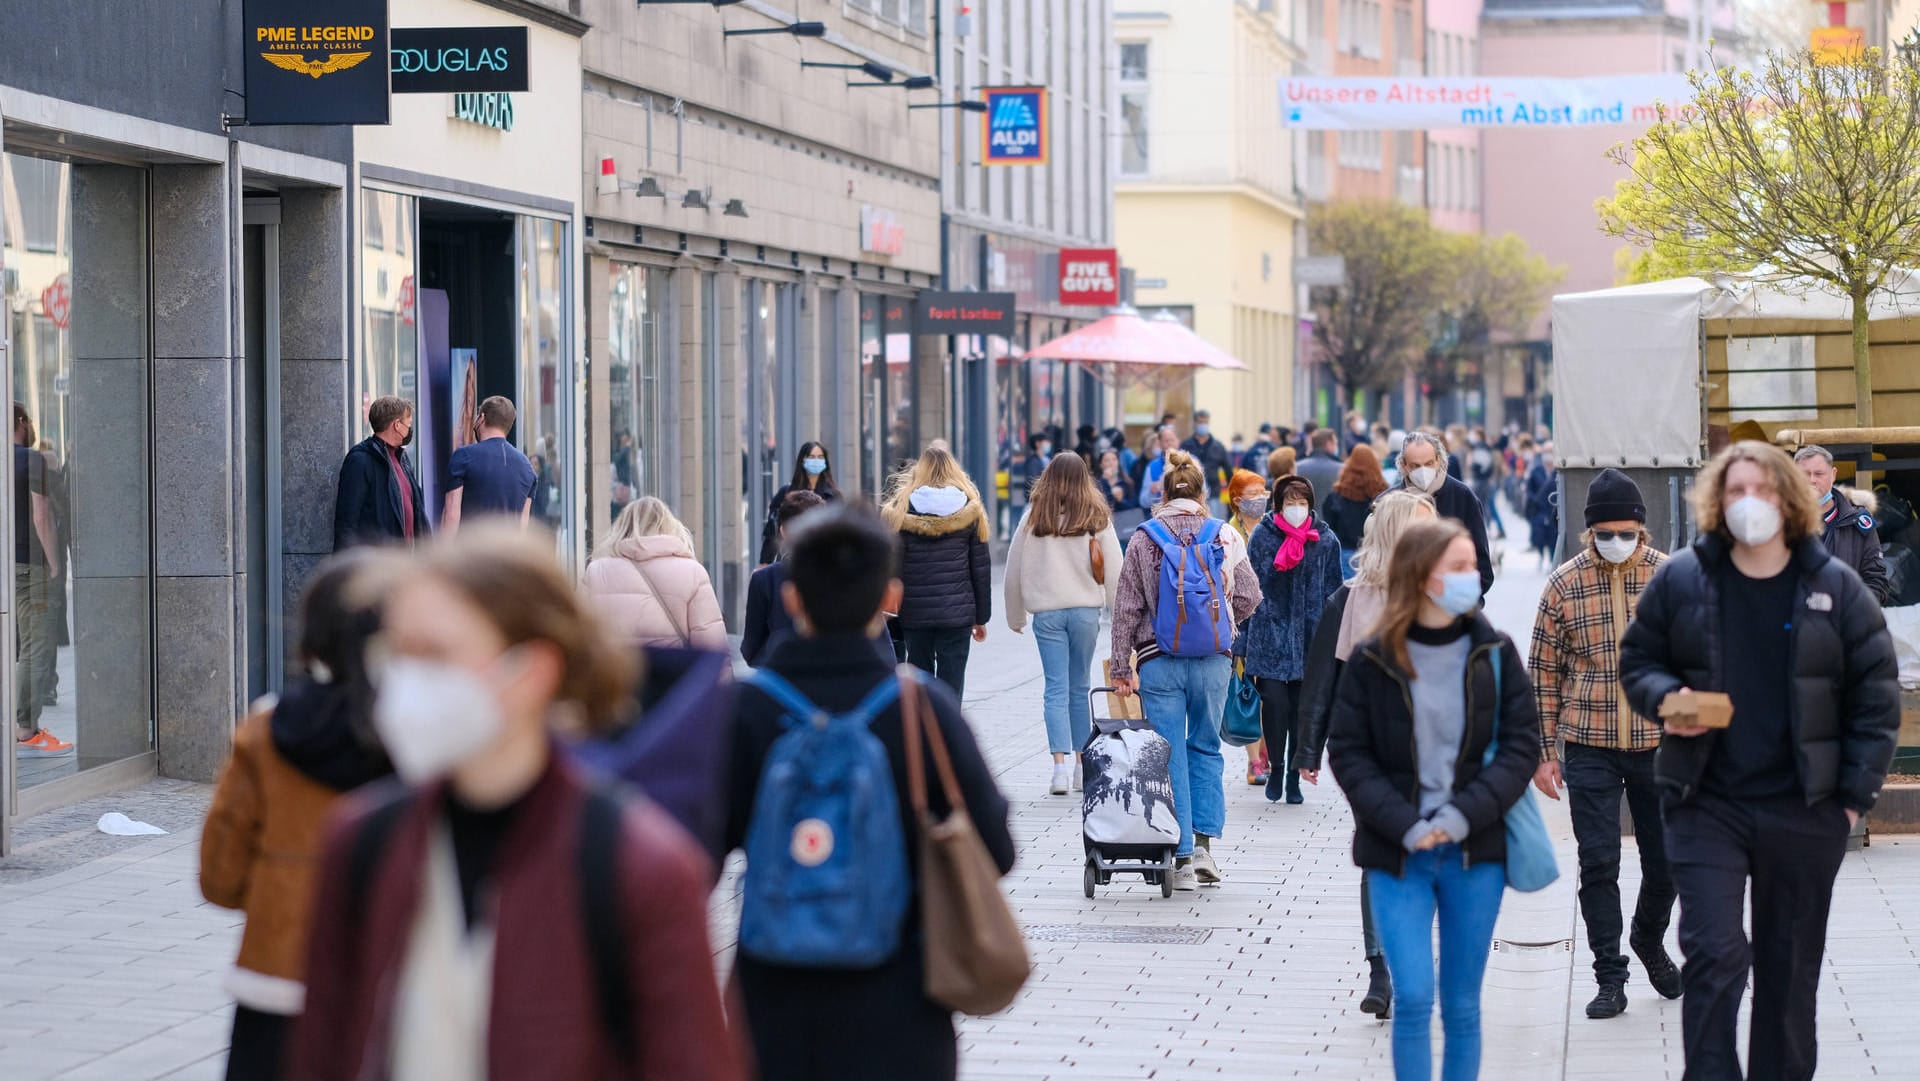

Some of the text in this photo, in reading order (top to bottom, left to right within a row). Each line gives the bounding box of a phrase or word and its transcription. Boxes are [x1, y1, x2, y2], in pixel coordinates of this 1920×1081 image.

[257, 26, 374, 42] PME LEGEND
[391, 47, 508, 72] DOUGLAS
[1287, 83, 1378, 103] Unsere
[1385, 82, 1492, 103] Altstadt
[1462, 103, 1504, 124] mit
[1513, 102, 1623, 124] Abstand
[992, 130, 1037, 146] ALDI
[1066, 262, 1109, 277] FIVE
[1062, 277, 1114, 292] GUYS
[929, 306, 1004, 320] Foot Locker
